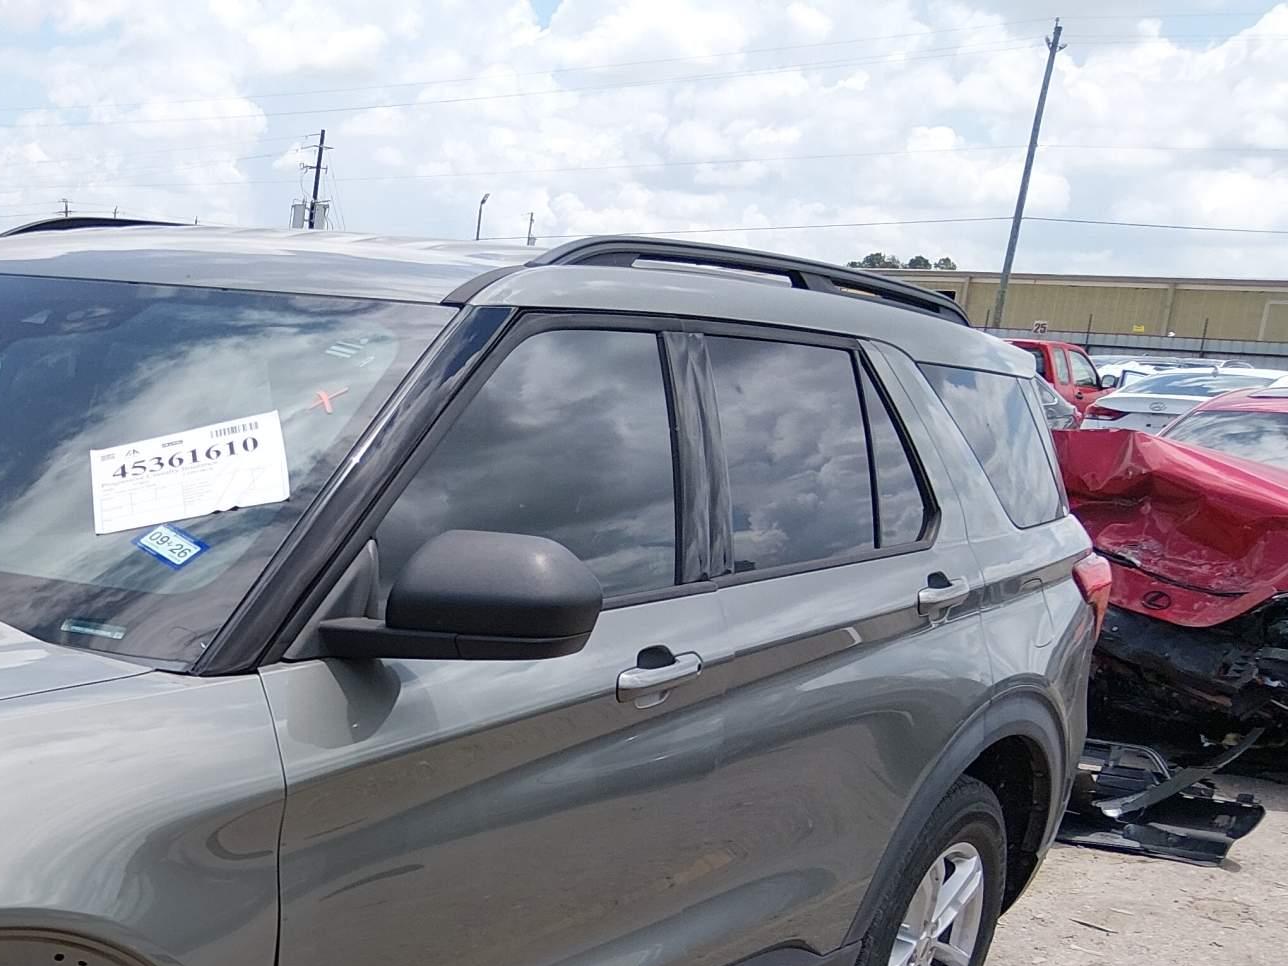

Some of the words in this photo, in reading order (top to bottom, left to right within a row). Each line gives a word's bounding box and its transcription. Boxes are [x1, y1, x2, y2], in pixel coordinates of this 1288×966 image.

[1033, 322, 1047, 334] 25
[112, 436, 259, 479] 45361610
[148, 530, 166, 546] 09
[170, 543, 192, 560] 26
